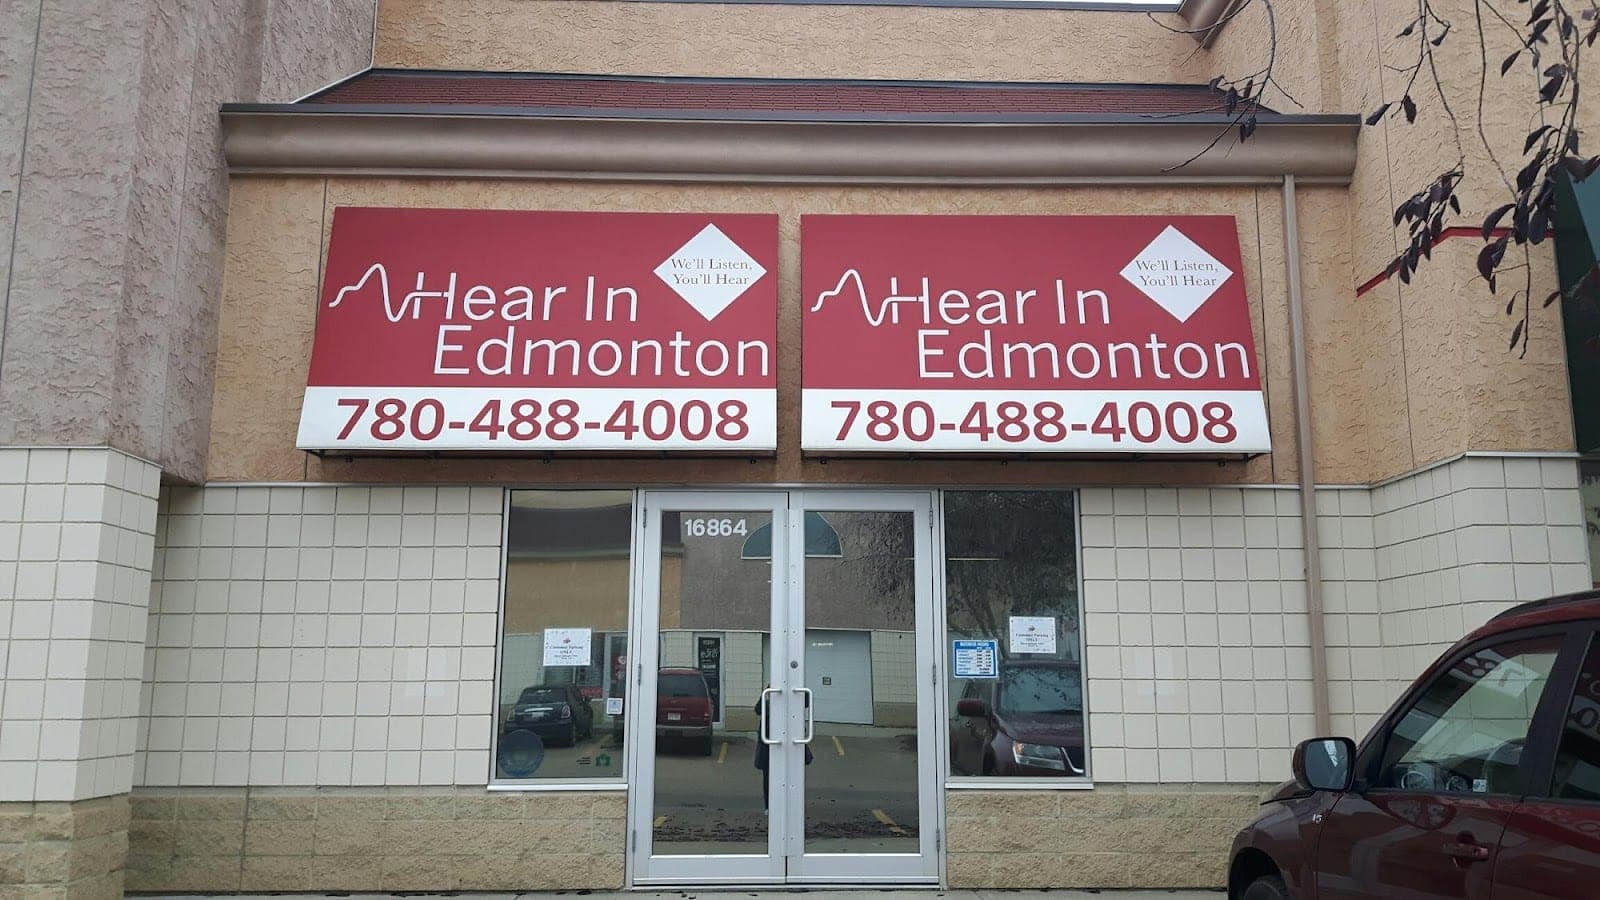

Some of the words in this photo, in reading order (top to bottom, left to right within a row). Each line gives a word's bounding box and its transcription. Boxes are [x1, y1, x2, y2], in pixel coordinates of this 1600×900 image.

[671, 258, 704, 270] We'll
[709, 258, 753, 271] Listen,
[673, 273, 711, 285] You'll
[716, 273, 750, 285] Hear
[1135, 260, 1169, 272] We'll
[1174, 260, 1219, 273] Listen,
[1140, 275, 1178, 287] You'll
[1183, 275, 1217, 287] Hear
[413, 271, 567, 322] Hear
[584, 275, 639, 322] In
[890, 276, 1037, 325] Hear
[1056, 278, 1110, 325] In
[432, 325, 769, 377] Edmonton
[917, 328, 1251, 379] Edmonton
[336, 398, 749, 441] 780-488-4008
[830, 400, 1238, 444] 780-488-4008
[684, 518, 748, 537] 16864
